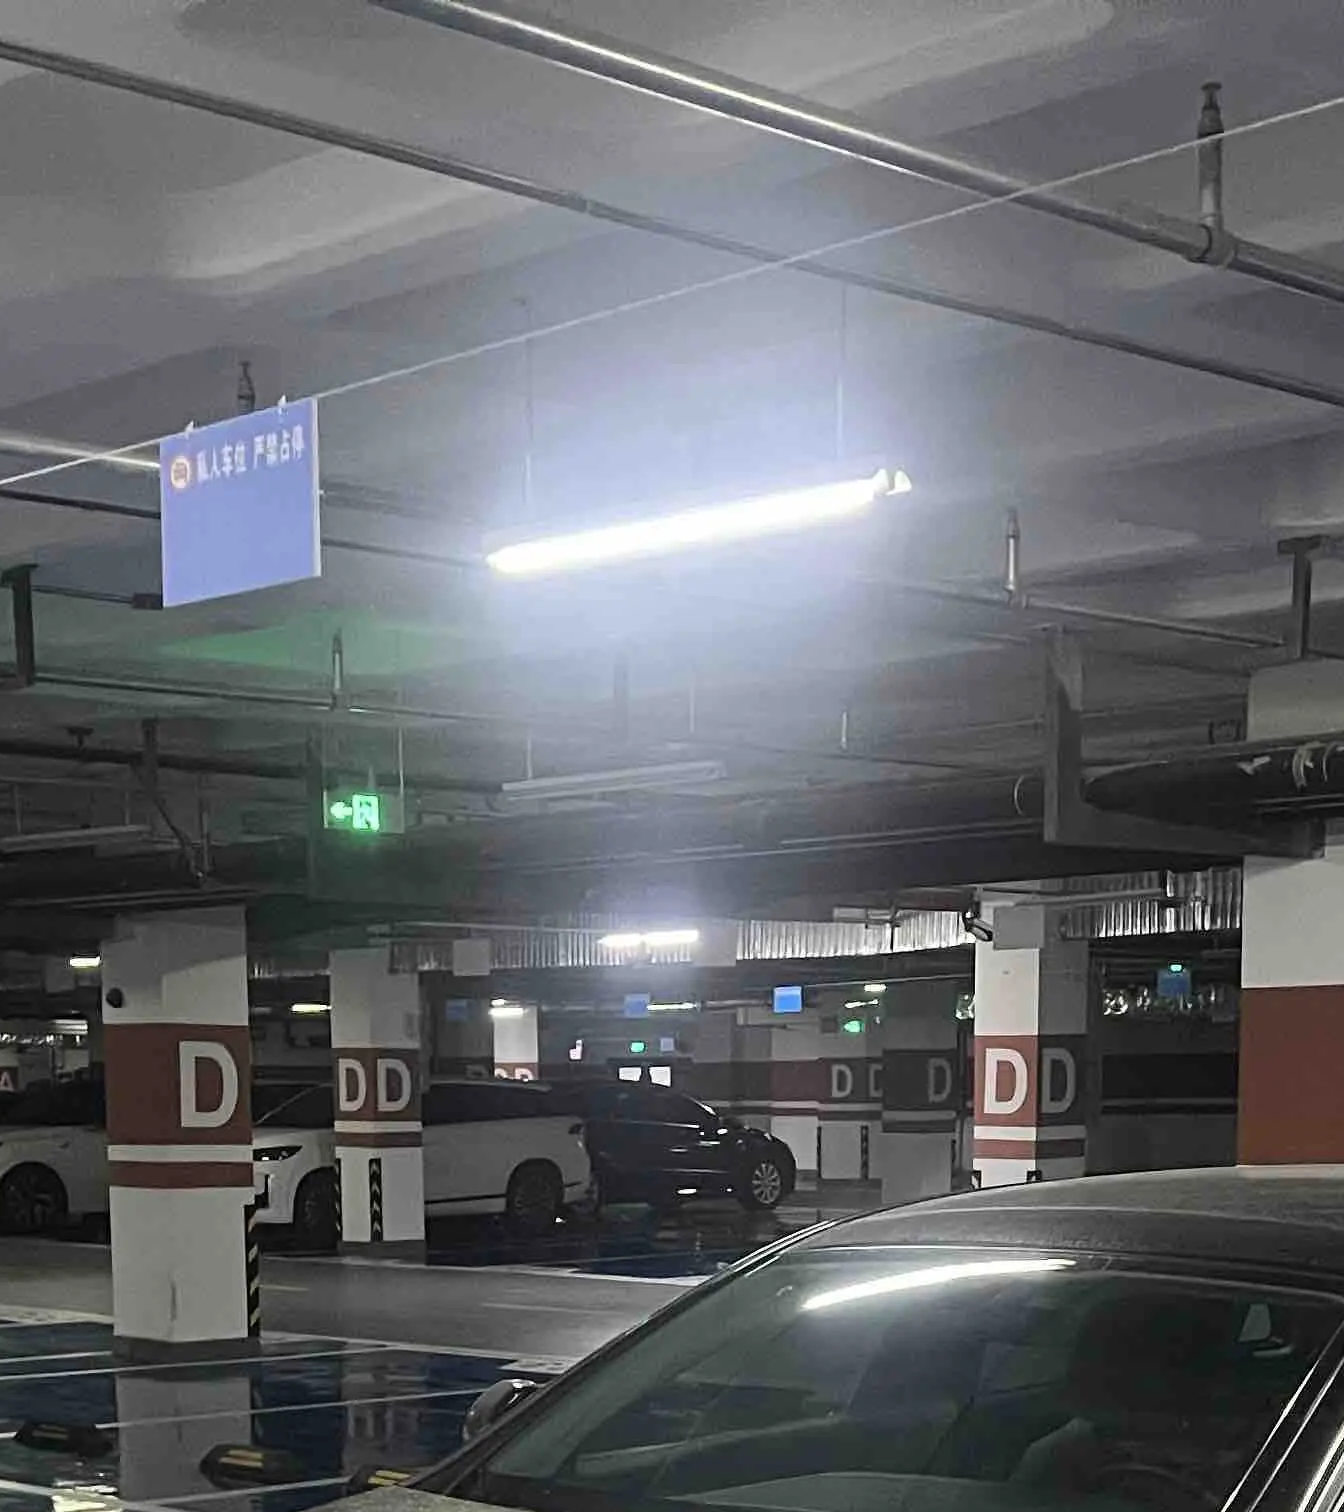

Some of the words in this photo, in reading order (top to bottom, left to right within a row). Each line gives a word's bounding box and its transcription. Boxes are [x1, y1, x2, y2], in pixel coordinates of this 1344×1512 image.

[180, 1041, 238, 1128] D
[339, 1058, 367, 1111] D
[376, 1058, 412, 1111] D
[831, 1063, 853, 1099] D
[928, 1058, 951, 1102] D
[984, 1048, 1028, 1115] D
[1041, 1047, 1077, 1114] D
